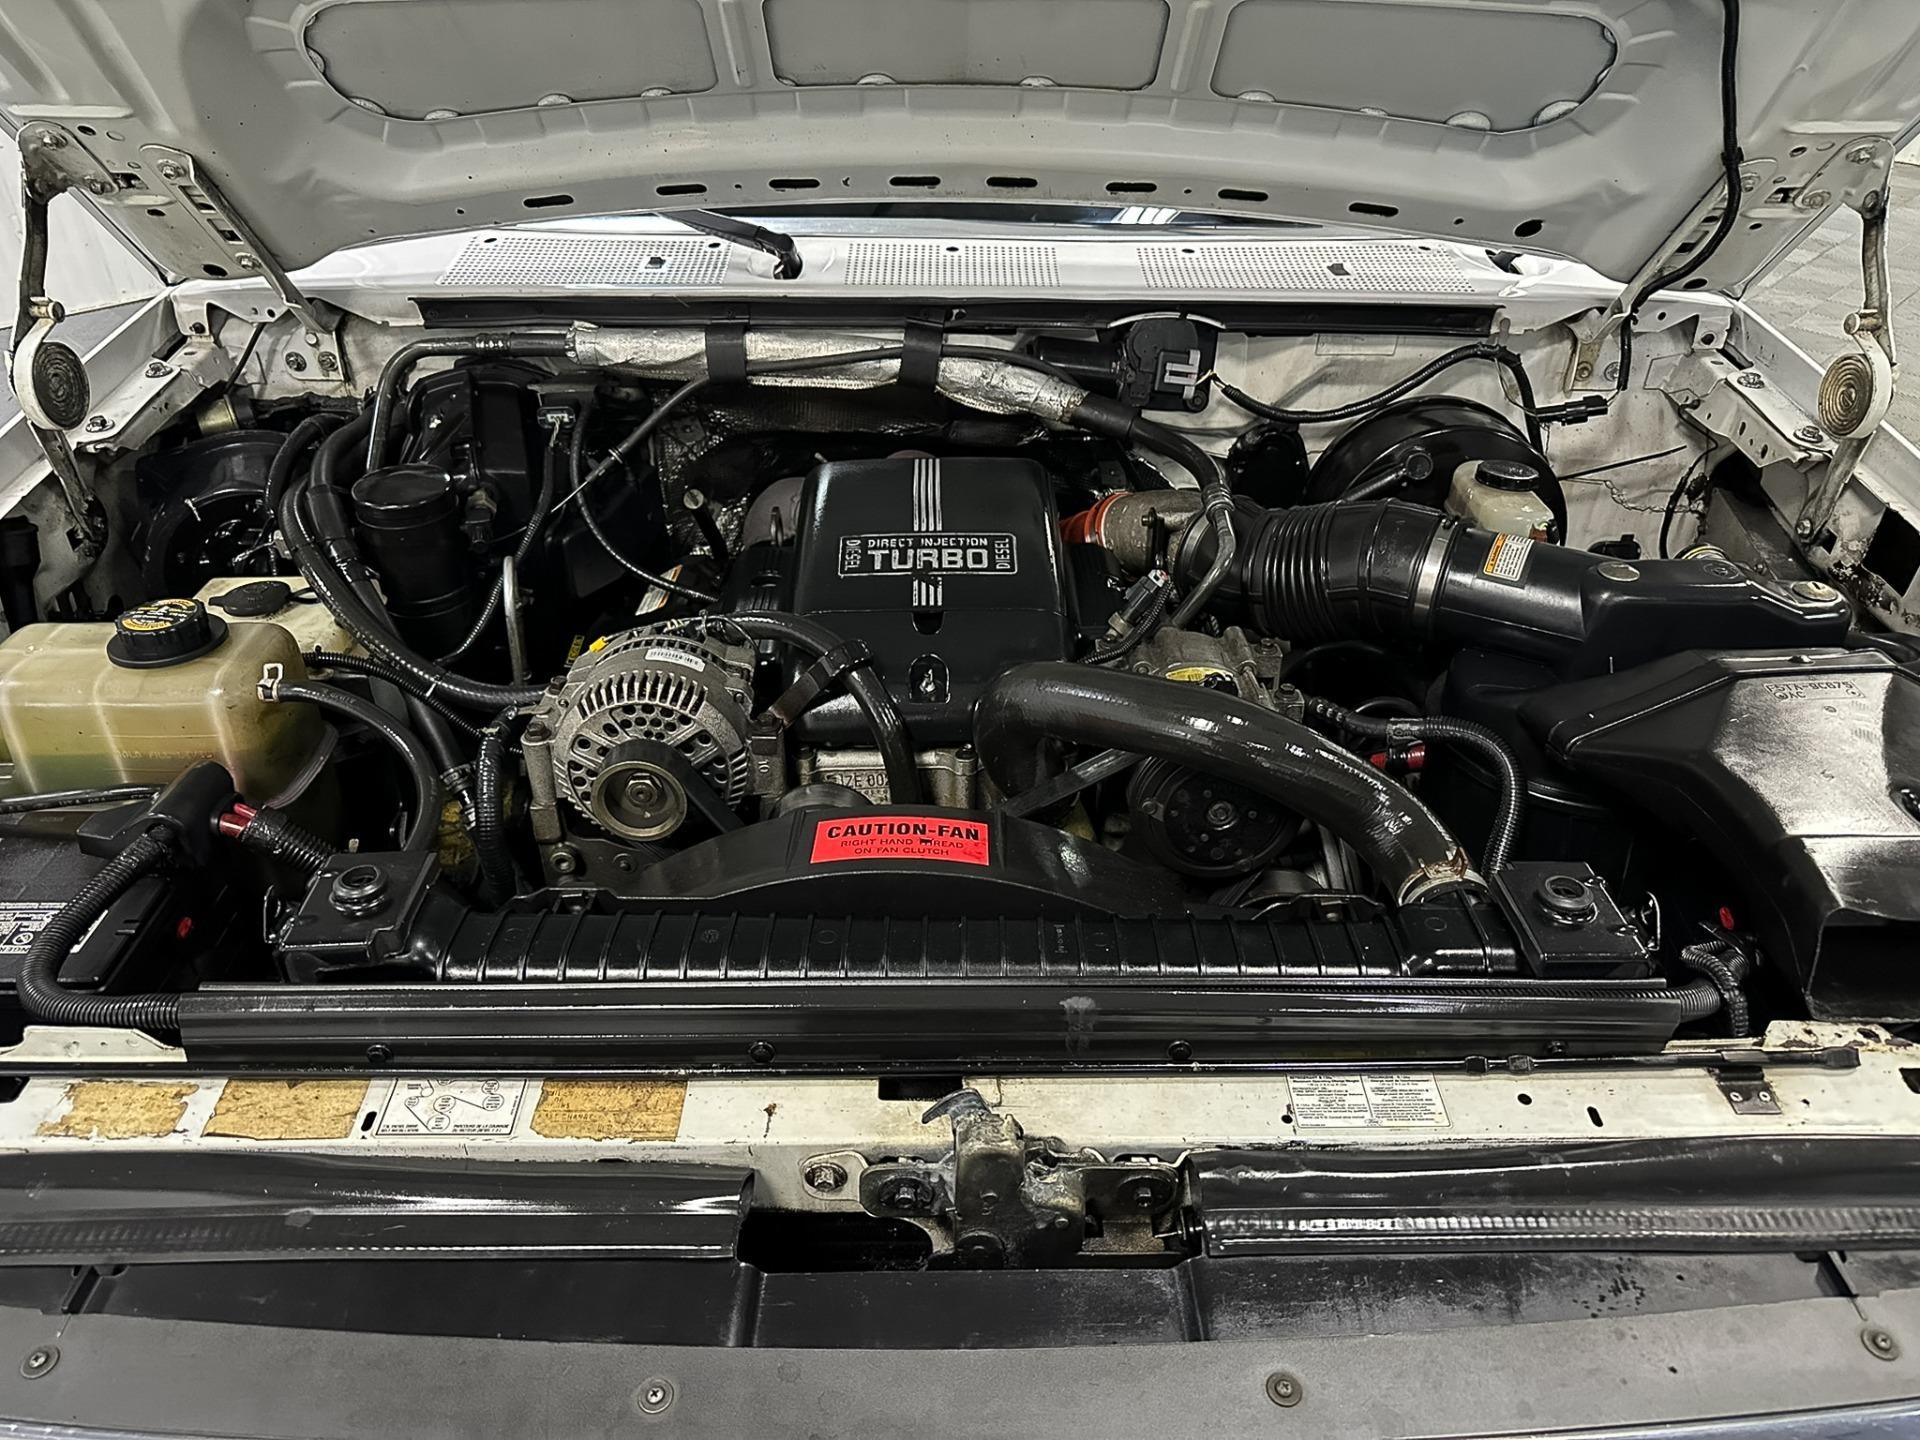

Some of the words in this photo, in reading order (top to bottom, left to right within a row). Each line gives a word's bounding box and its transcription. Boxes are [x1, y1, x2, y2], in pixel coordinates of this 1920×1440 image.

[867, 537, 914, 548] DIRECT
[920, 537, 988, 548] INJECTION
[844, 539, 862, 571] DIESEL
[867, 549, 989, 570] TURBO
[994, 538, 1011, 570] DIESEL
[827, 823, 980, 841] CAUTION-FAN
[840, 838, 876, 848] RIGHT
[880, 838, 914, 846] HAND
[919, 838, 964, 849] READ
[902, 847, 950, 856] CLUTCH
